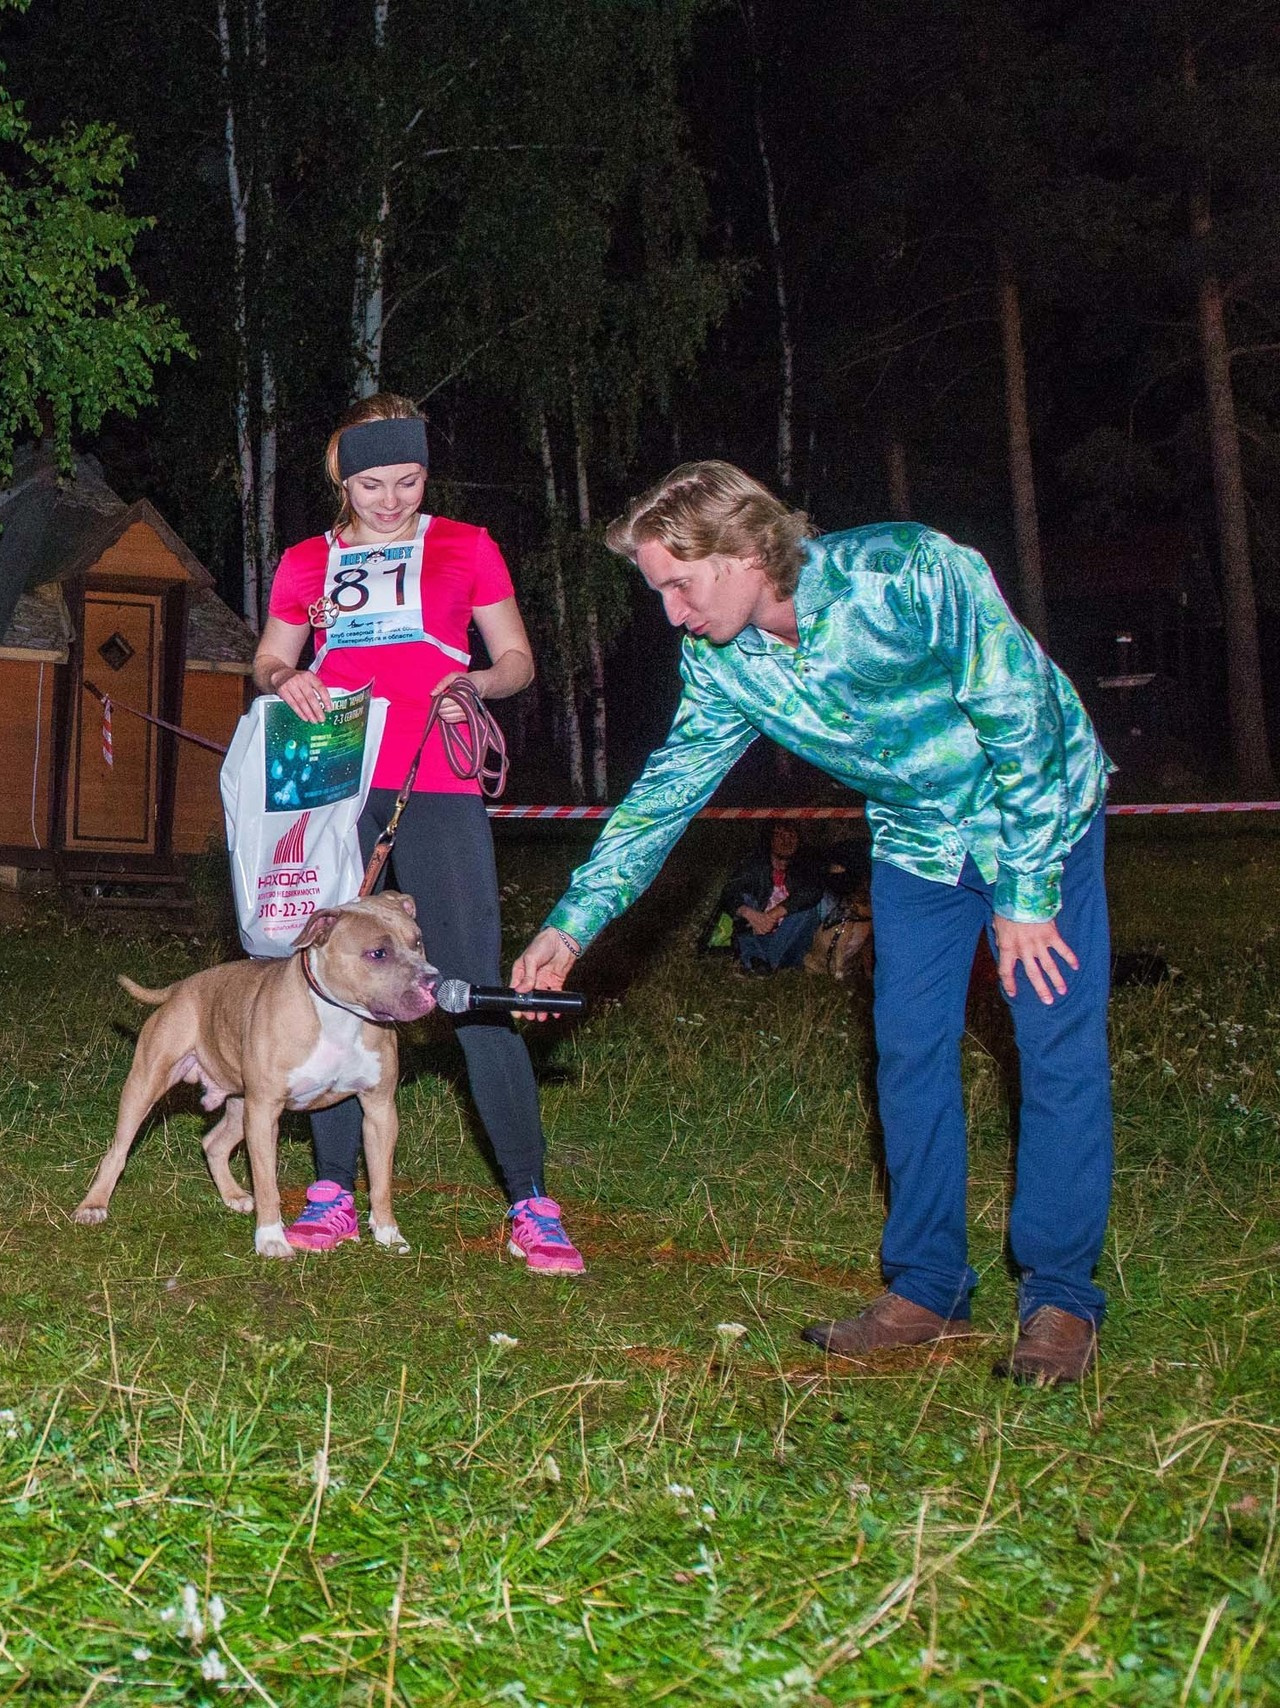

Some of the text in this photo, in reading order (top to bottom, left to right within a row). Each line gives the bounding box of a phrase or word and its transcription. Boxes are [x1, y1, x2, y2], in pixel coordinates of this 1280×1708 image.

[339, 546, 414, 566] HEY HEY
[330, 563, 407, 612] 81
[333, 713, 344, 725] 2-3
[258, 870, 318, 889] НАХОДКА
